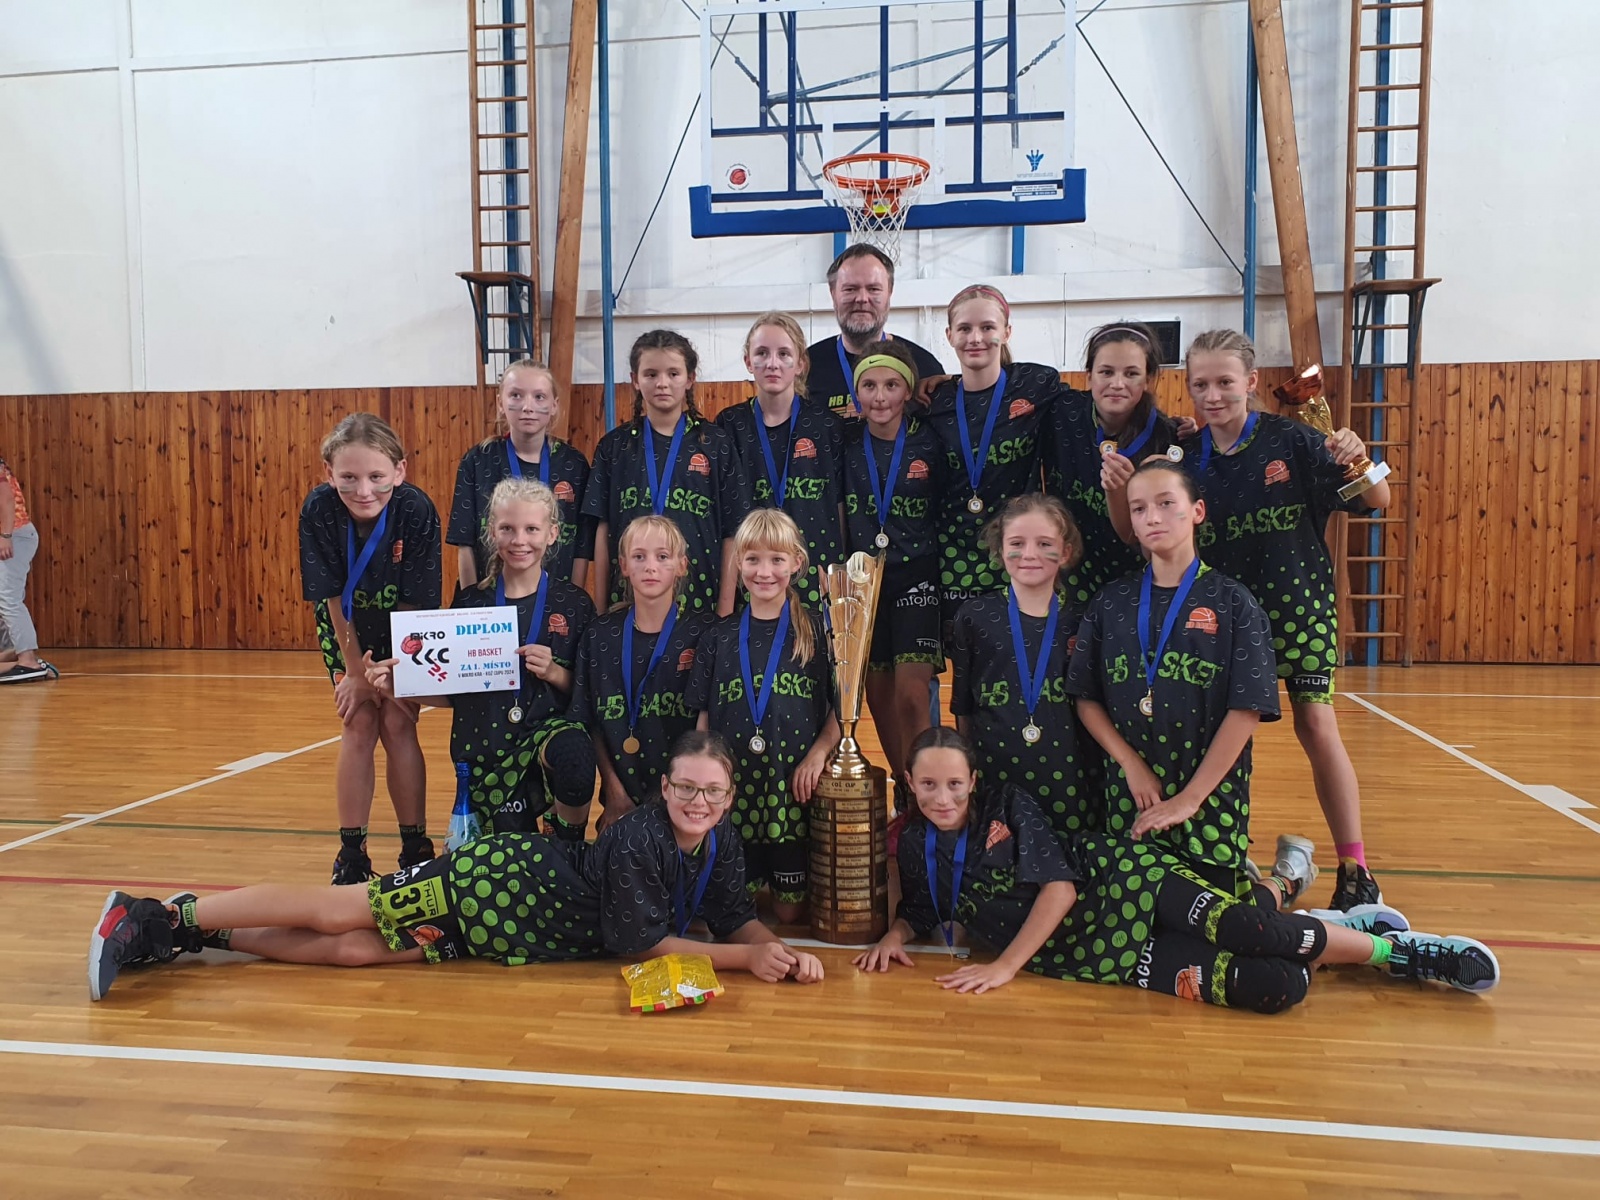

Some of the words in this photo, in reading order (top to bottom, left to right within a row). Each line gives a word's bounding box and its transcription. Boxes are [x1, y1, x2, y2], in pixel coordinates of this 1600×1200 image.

[828, 395, 844, 408] HB
[456, 622, 513, 636] DIPLOM
[467, 649, 477, 658] HB
[478, 647, 502, 657] BASKET
[483, 660, 512, 669] MÍSTO
[1293, 677, 1330, 686] THUR
[773, 873, 806, 884] THUR
[422, 880, 438, 917] THUR
[389, 887, 427, 925] 31
[1187, 890, 1215, 926] THUR
[1300, 929, 1316, 949] NBA
